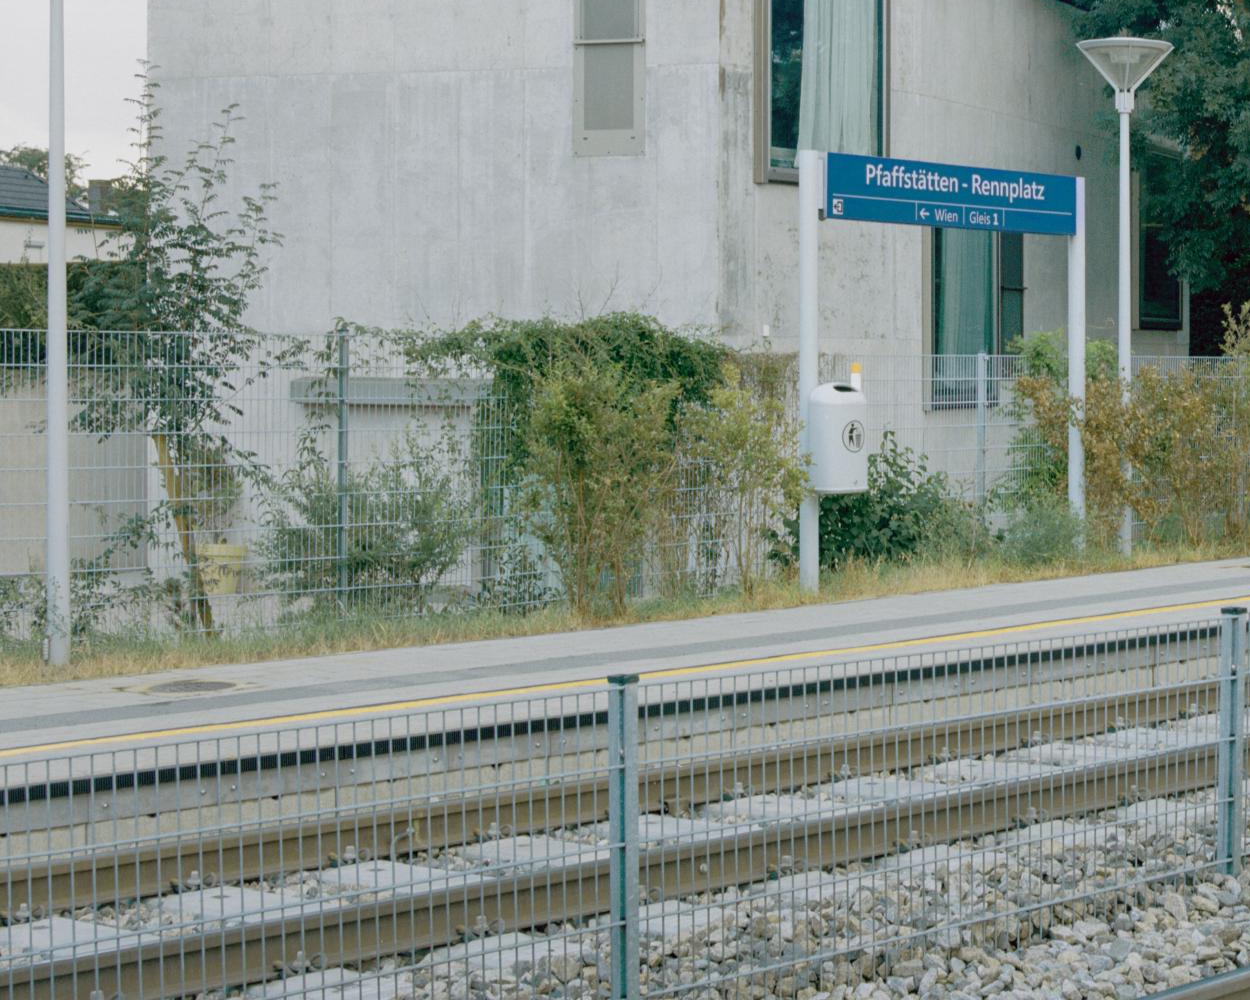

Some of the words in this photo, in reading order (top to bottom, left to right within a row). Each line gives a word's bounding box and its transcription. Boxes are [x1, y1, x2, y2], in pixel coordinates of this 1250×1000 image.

[866, 164, 959, 193] Pfaffstätten
[971, 174, 1045, 203] Rennplatz
[934, 208, 959, 223] Wien
[969, 210, 991, 225] Gleis
[993, 211, 999, 226] 1
